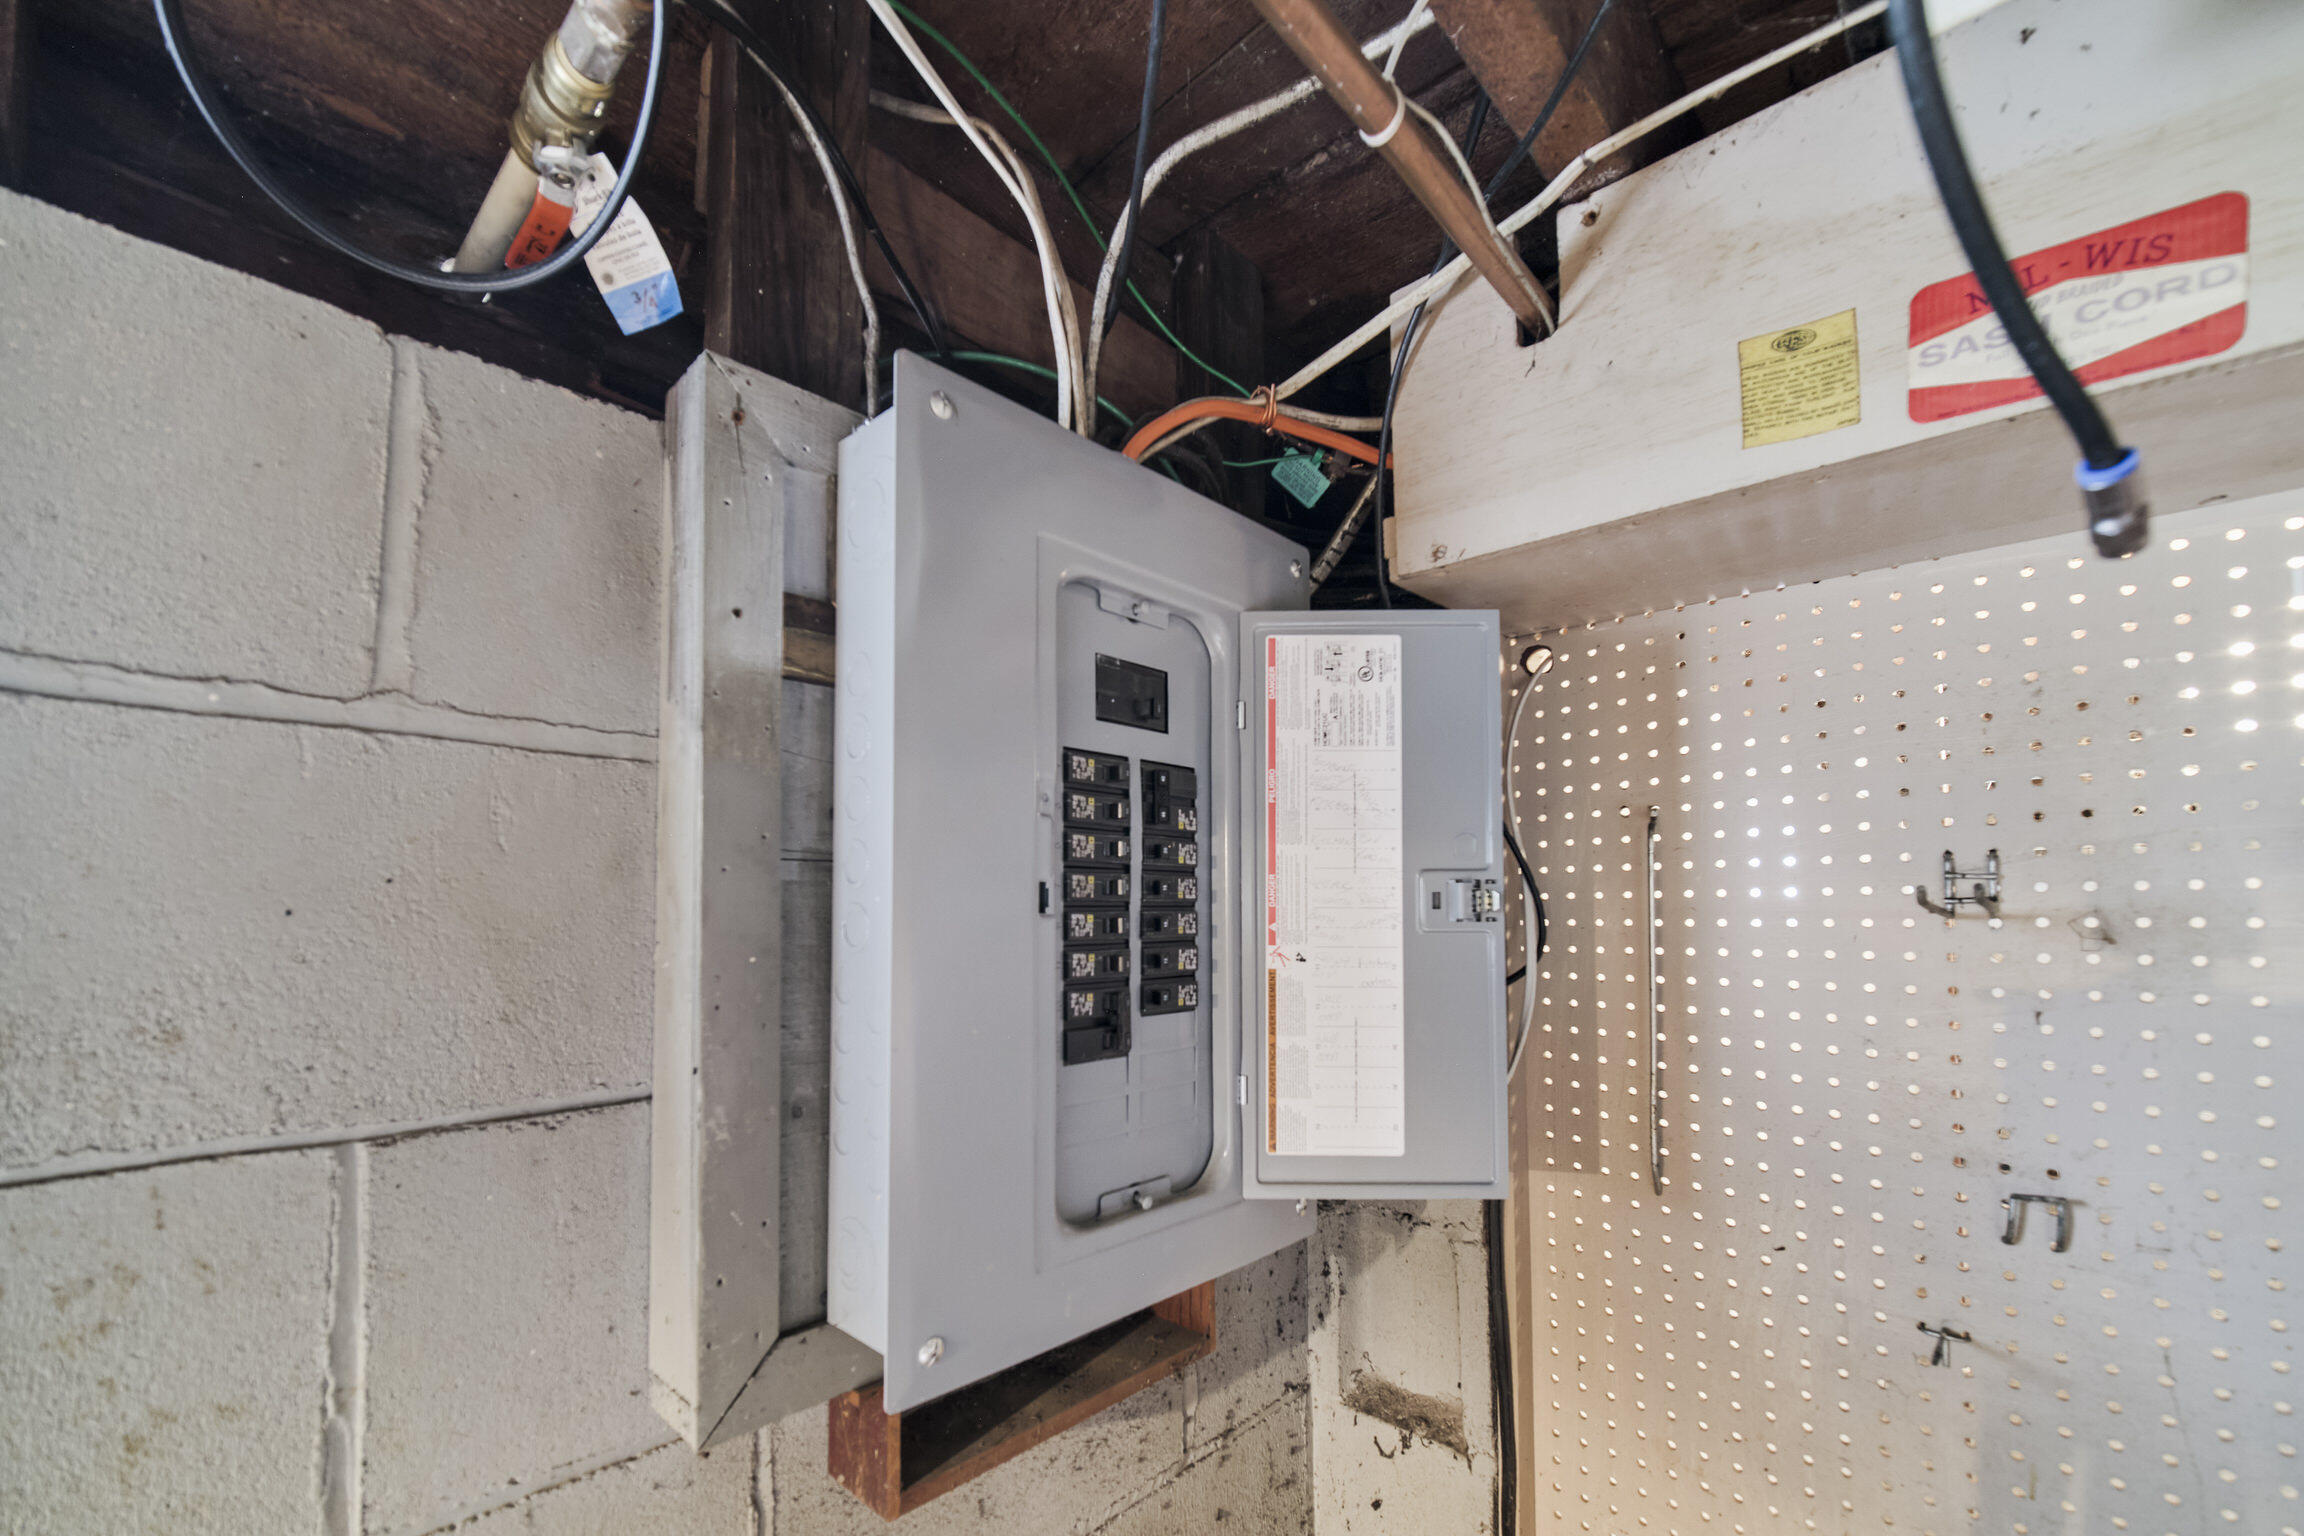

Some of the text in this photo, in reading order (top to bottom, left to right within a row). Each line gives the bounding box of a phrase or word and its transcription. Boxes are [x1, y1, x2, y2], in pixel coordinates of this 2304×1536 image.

[2075, 262, 2238, 324] CORD
[1268, 666, 1276, 699] DANGER
[1268, 768, 1276, 803] PELIGRO
[1268, 874, 1276, 907] DANGER
